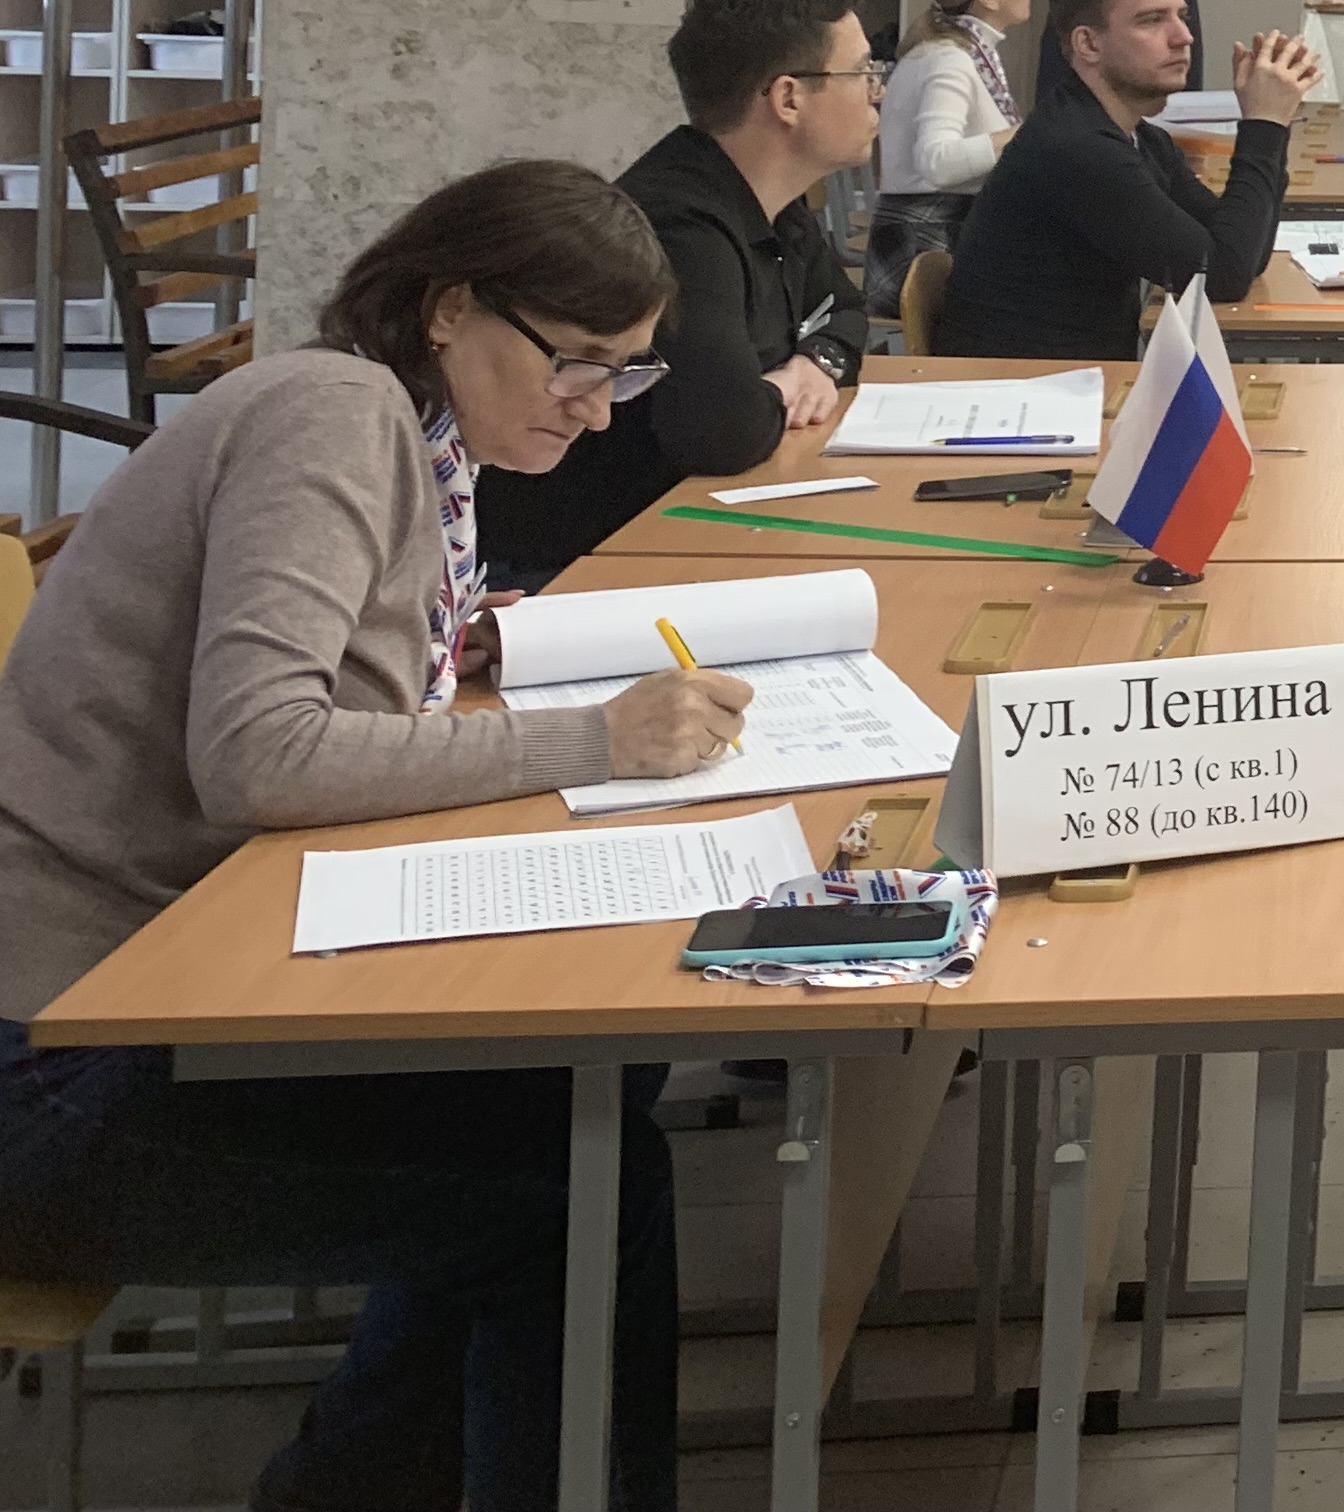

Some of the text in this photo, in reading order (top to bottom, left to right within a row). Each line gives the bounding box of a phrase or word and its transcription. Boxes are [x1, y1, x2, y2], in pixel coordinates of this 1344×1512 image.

[1001, 676, 1333, 758] ул. Ленина
[1060, 747, 1298, 796] № 74/13 (с кв.1)
[1060, 789, 1308, 842] № 88 (до кв.140)
